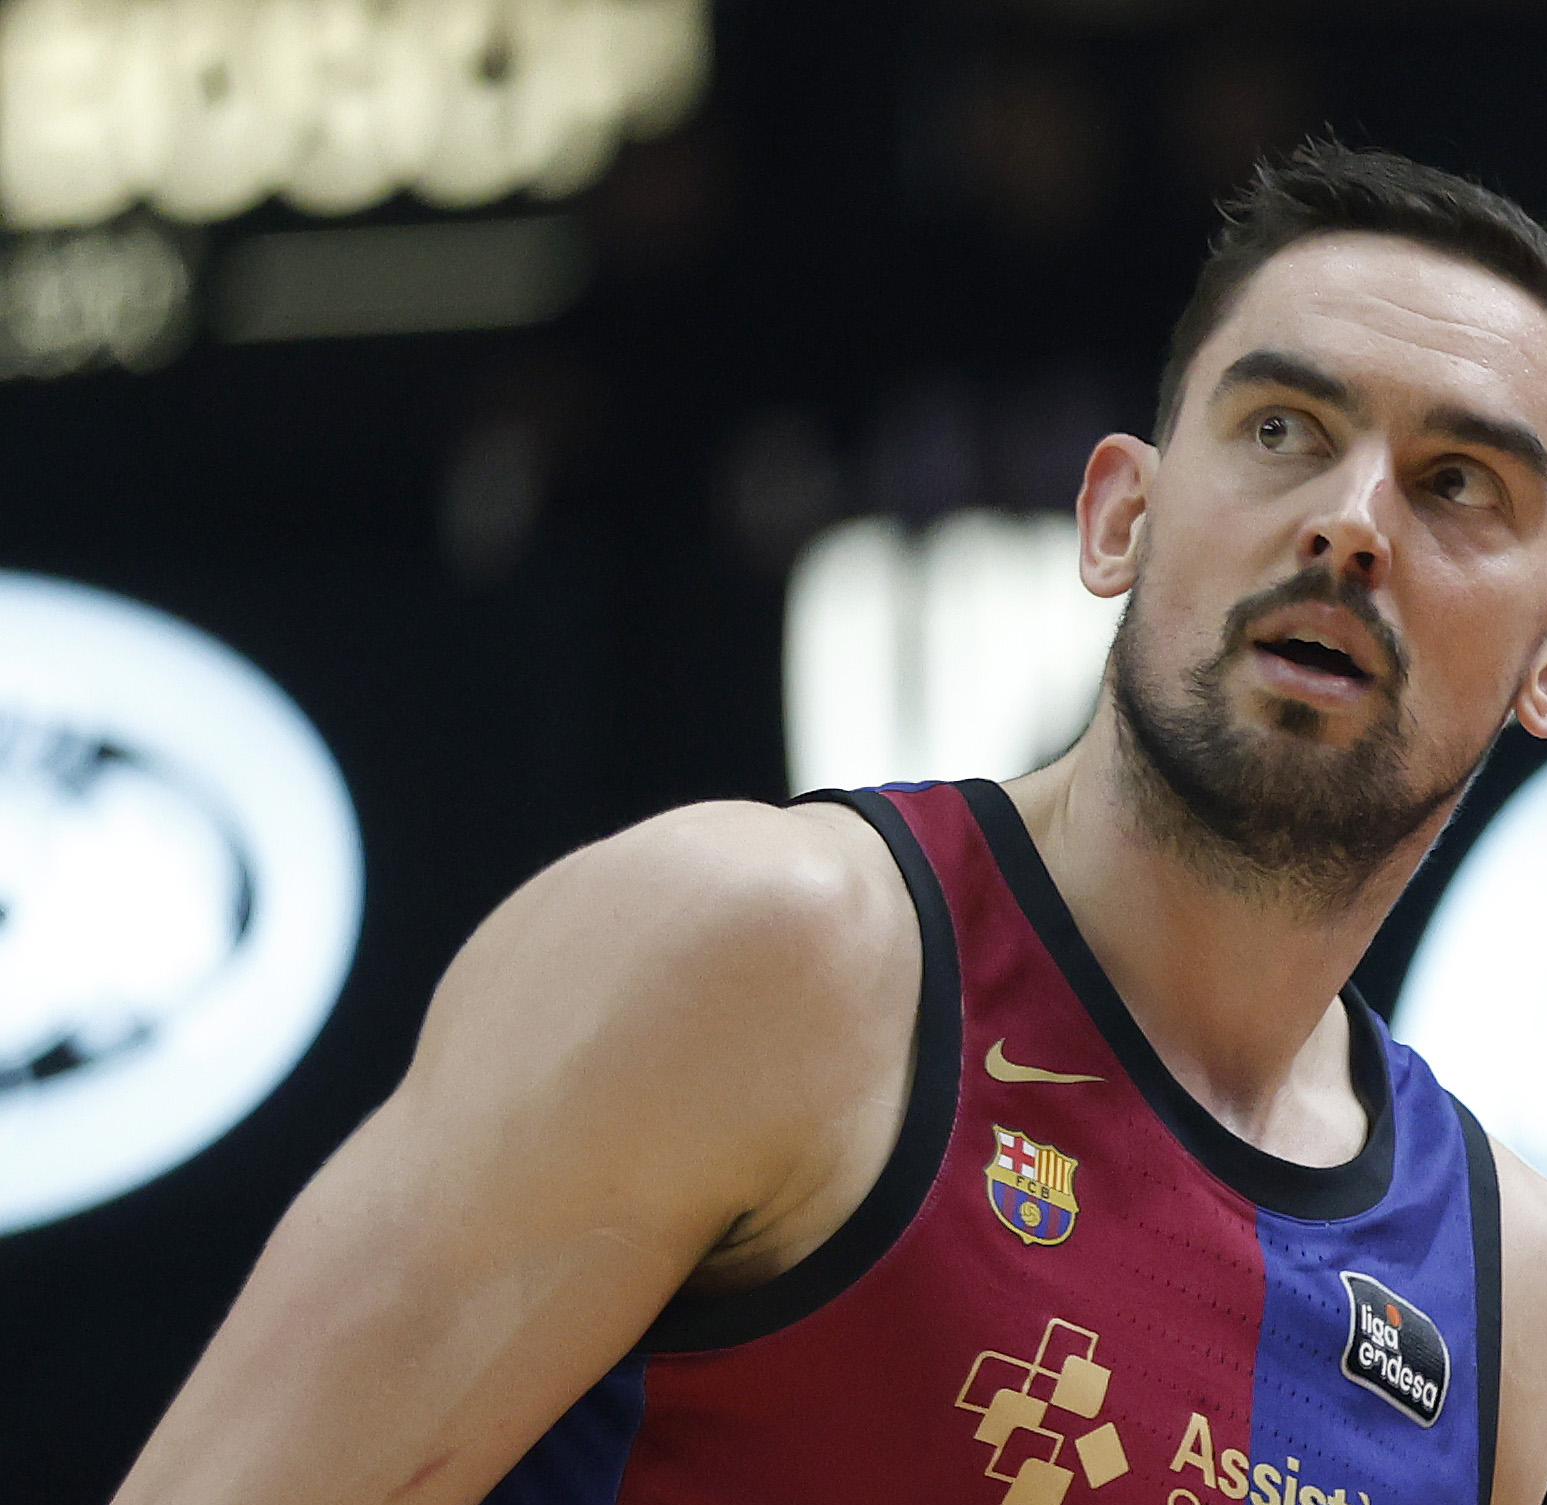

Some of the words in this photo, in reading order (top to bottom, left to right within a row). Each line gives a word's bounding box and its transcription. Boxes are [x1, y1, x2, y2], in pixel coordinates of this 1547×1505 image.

[1016, 1176, 1050, 1199] FCB
[1360, 1303, 1399, 1350] liga
[1358, 1341, 1438, 1409] endesa
